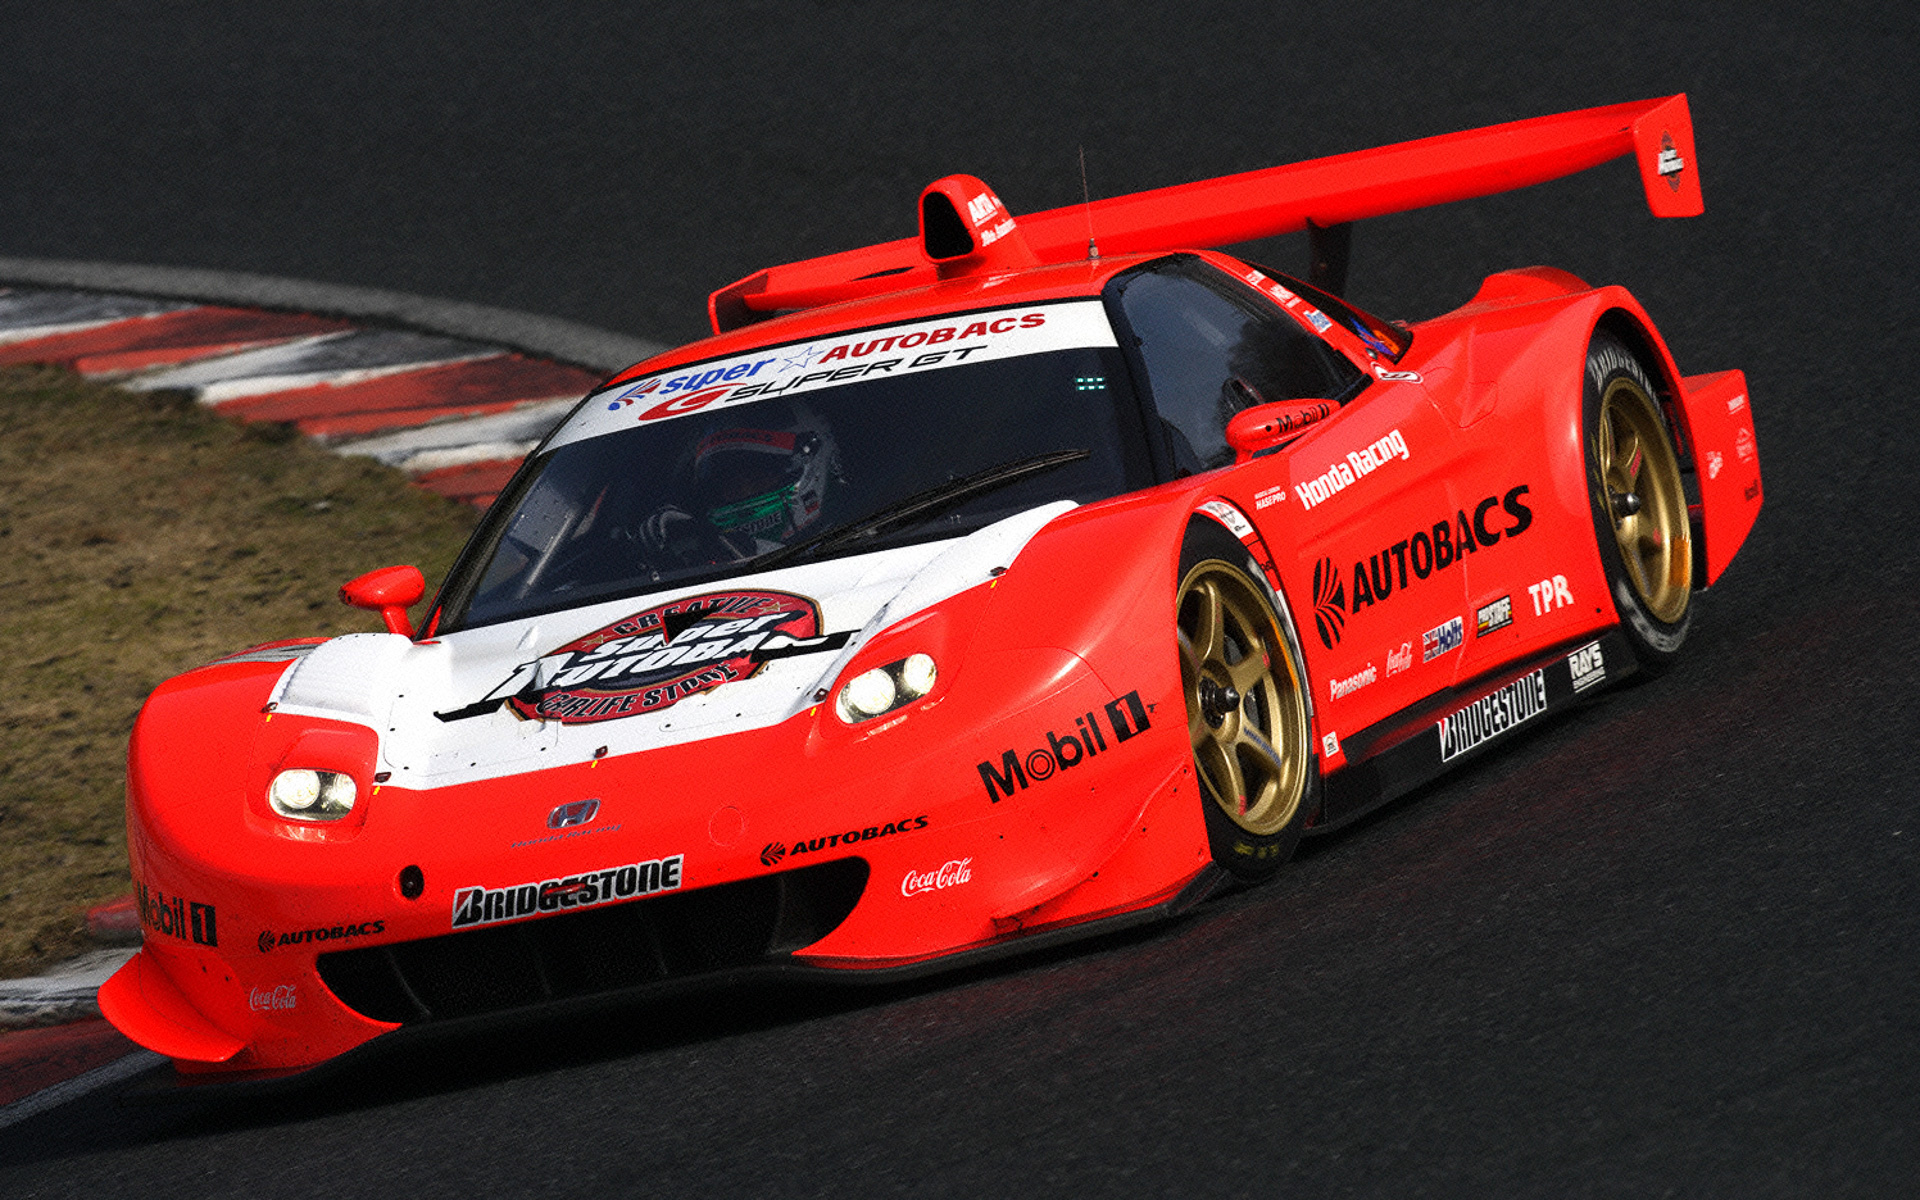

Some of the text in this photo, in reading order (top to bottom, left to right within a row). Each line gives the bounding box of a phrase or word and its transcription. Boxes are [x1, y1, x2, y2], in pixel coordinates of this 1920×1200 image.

[659, 312, 1046, 396] super AUTOBACS
[725, 345, 988, 403] SUPER GT
[1294, 428, 1411, 511] Honda Racing
[1351, 484, 1533, 615] AUTOBACS
[1527, 573, 1575, 617] TPR
[1329, 661, 1377, 702] Panasonic
[1568, 642, 1604, 680] RAYS
[1436, 667, 1548, 763] BRIDGESTONE
[976, 711, 1107, 804] Mobil
[789, 814, 929, 857] AUTOBACS
[451, 853, 685, 930] BRIDGESTONE
[901, 856, 973, 897] Coca-Cola
[136, 880, 187, 941] Mobil
[277, 919, 385, 947] AUTOBACS
